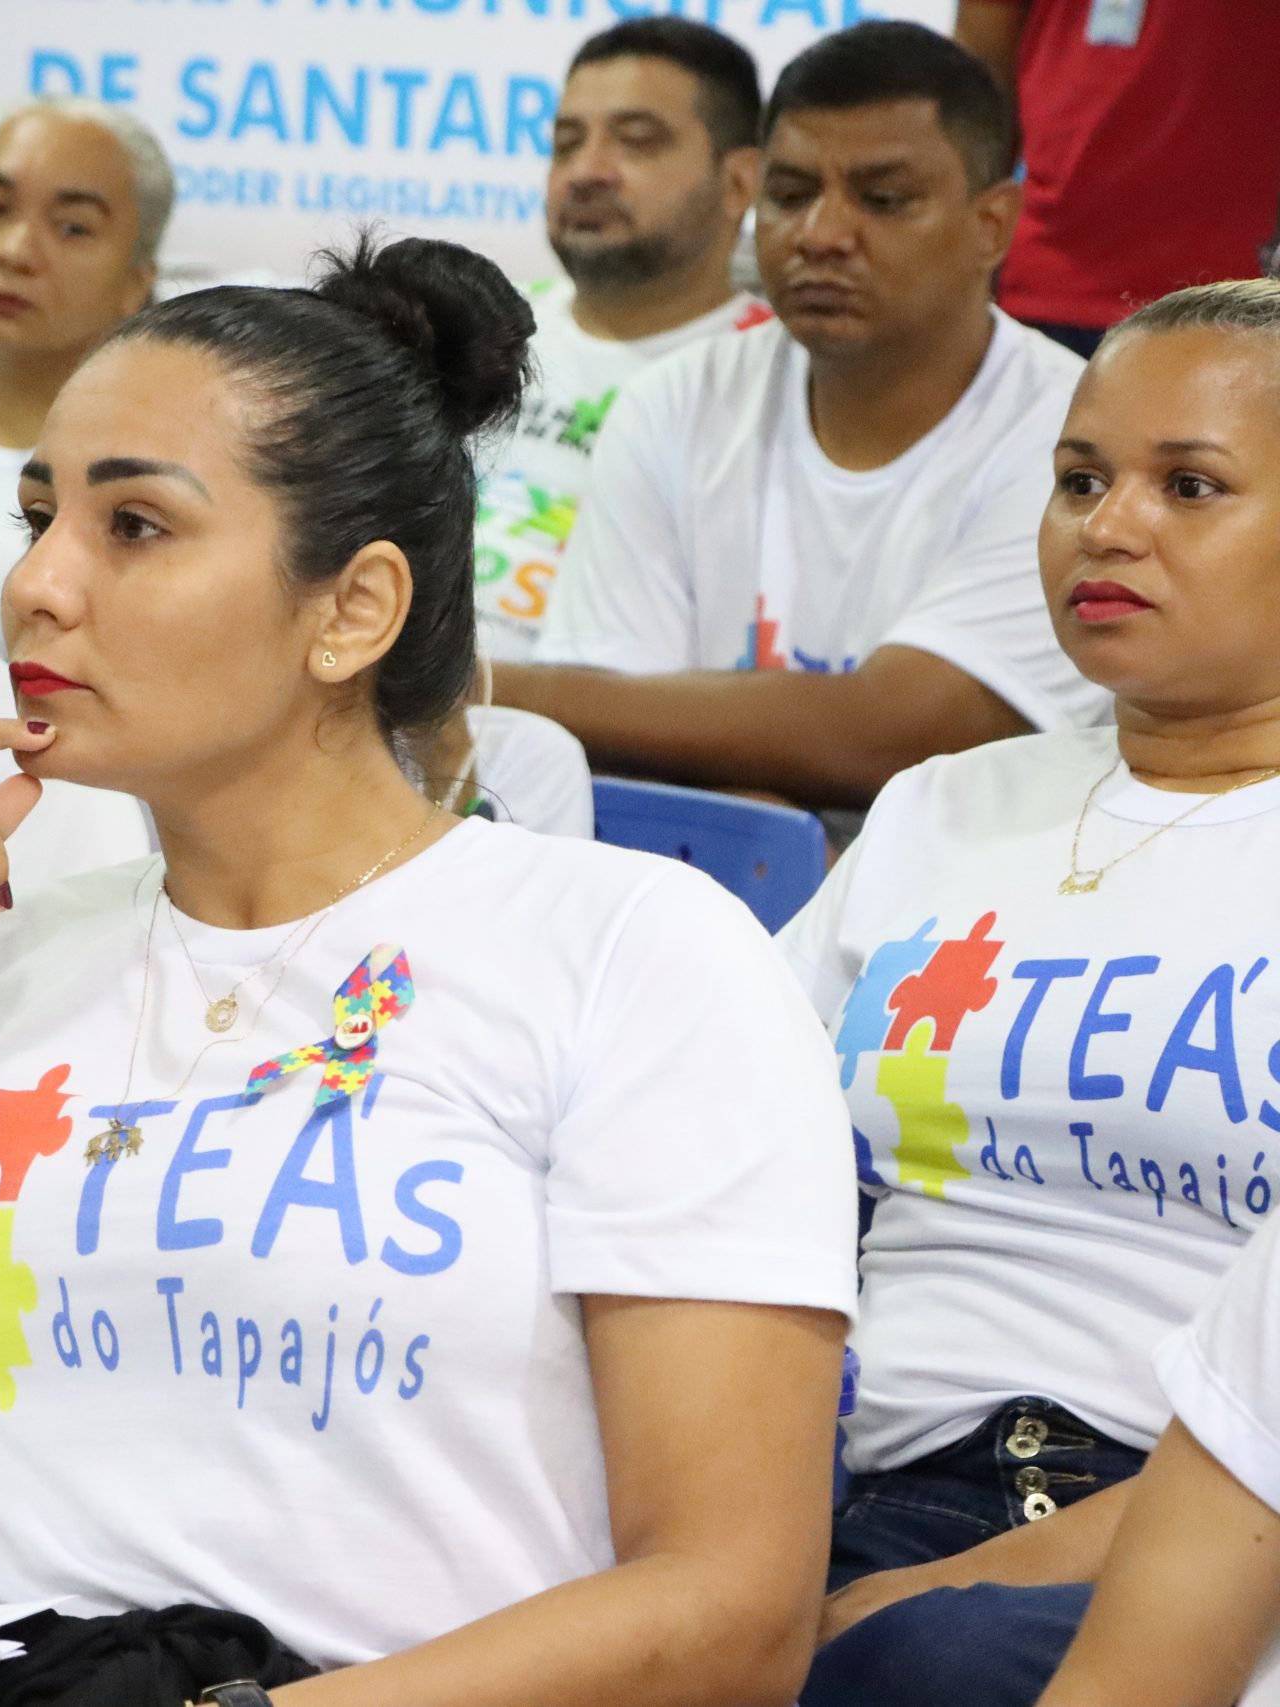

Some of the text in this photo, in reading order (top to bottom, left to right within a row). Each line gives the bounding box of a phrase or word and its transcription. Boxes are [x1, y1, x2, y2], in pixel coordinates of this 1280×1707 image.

[175, 55, 555, 157] SANTAR
[294, 171, 544, 222] LEGISLATIV
[980, 1116, 1273, 1229] do Tapajó
[52, 1276, 431, 1433] do Tapajós
